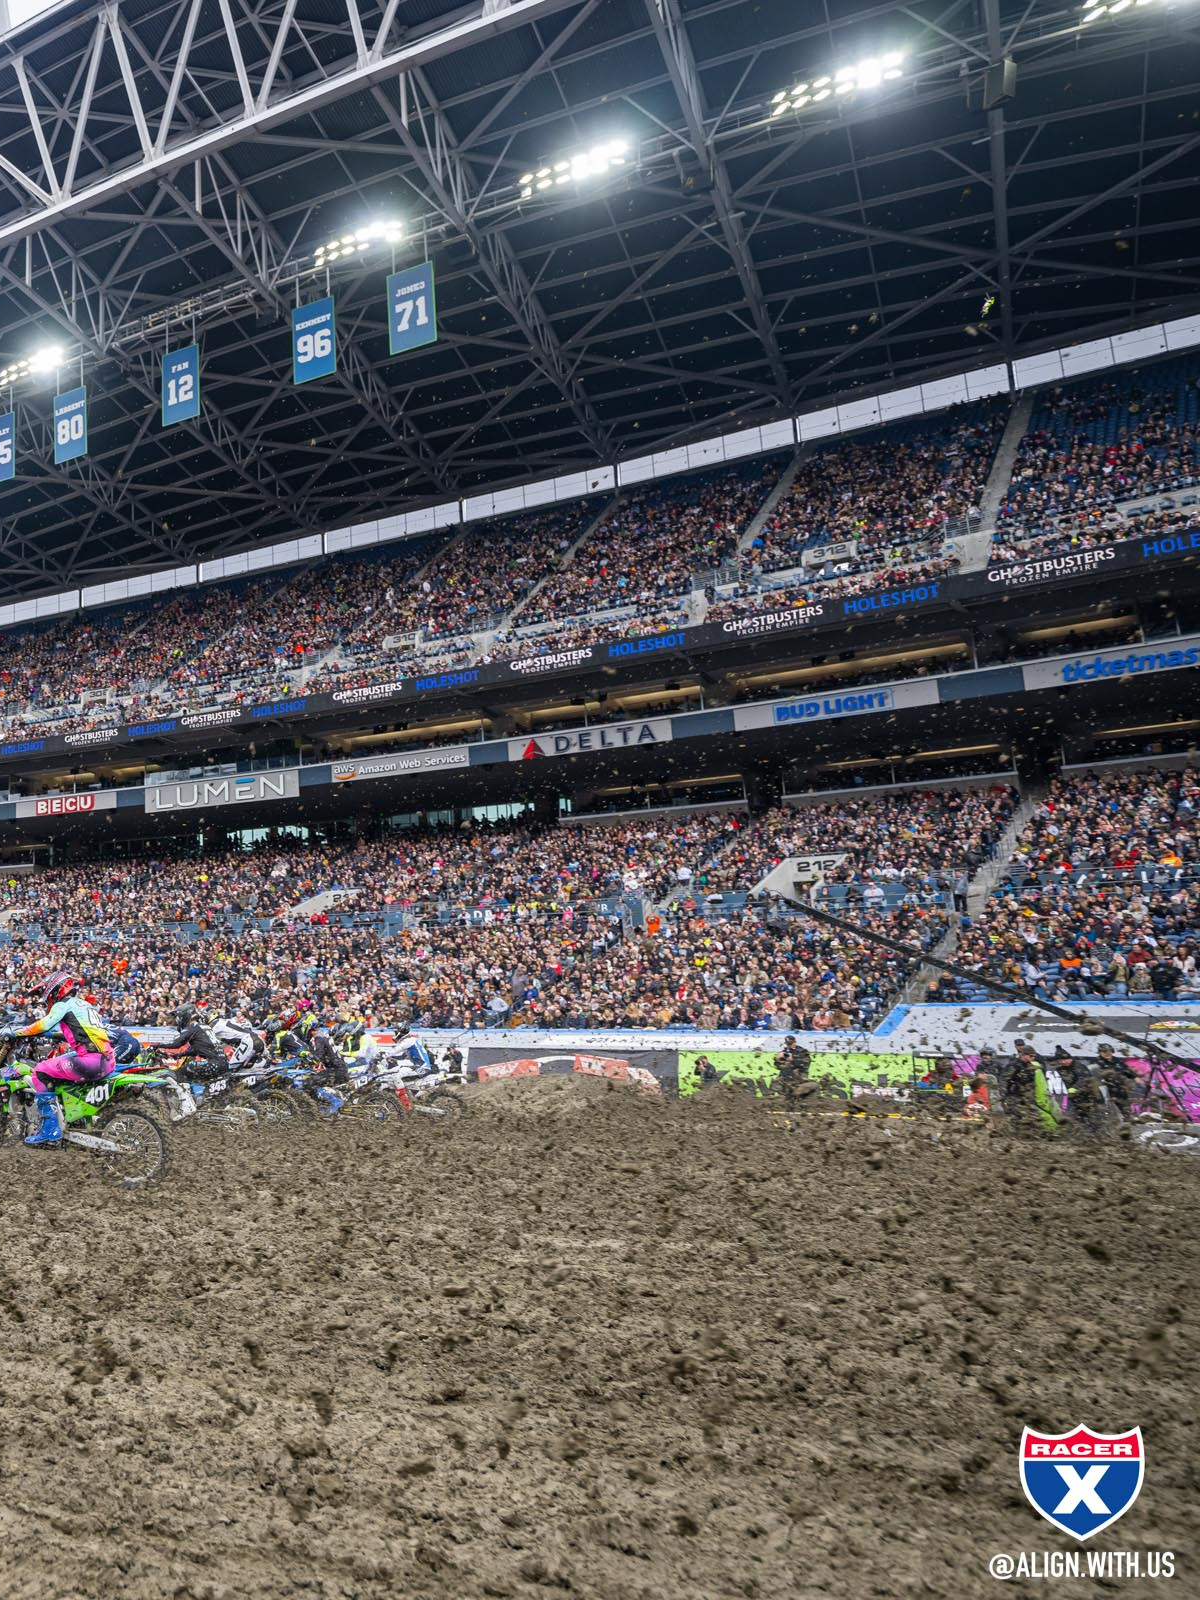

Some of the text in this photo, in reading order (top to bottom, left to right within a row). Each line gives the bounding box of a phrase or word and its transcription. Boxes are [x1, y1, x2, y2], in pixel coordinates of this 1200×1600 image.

[395, 281, 425, 297] JONES
[395, 296, 428, 332] 71
[297, 328, 331, 364] 96
[168, 374, 194, 406] 12
[57, 414, 83, 445] 80
[813, 544, 847, 558] 312
[1143, 532, 1200, 557] HOLE
[987, 547, 1115, 583] GHOSTBUSTERS
[1005, 562, 1099, 586] FROZEN EMPIRE
[844, 584, 939, 615] HOLESHOT
[723, 605, 823, 633] GHOSTBUSTERS
[736, 617, 810, 637] FROZEN EMPIRE
[608, 632, 686, 658] HOLESHOT
[510, 648, 592, 671] GHOSTBUSTERS
[521, 659, 582, 675] FROZEN EMPIRE
[1062, 648, 1200, 682] ticketmas
[332, 681, 402, 702] GHOSTBUSTERS
[415, 669, 480, 692] HOLESHOT
[252, 699, 308, 718] HOLESHOT
[342, 691, 393, 705] FROZEN EMPIRE
[776, 692, 887, 721] BUD LIGHT
[127, 720, 176, 737] HOLESHOT
[181, 708, 241, 726] GHOSTBUSTERS
[64, 728, 118, 744] GHOSTBUSTERS
[554, 724, 656, 754] DELTA
[1, 740, 45, 756] HOLESHOT
[334, 753, 465, 775] aws Amazon Web Services
[156, 774, 284, 809] LUMEN
[797, 859, 836, 872] 212
[85, 1084, 109, 1104] 401
[209, 1080, 227, 1093] 343
